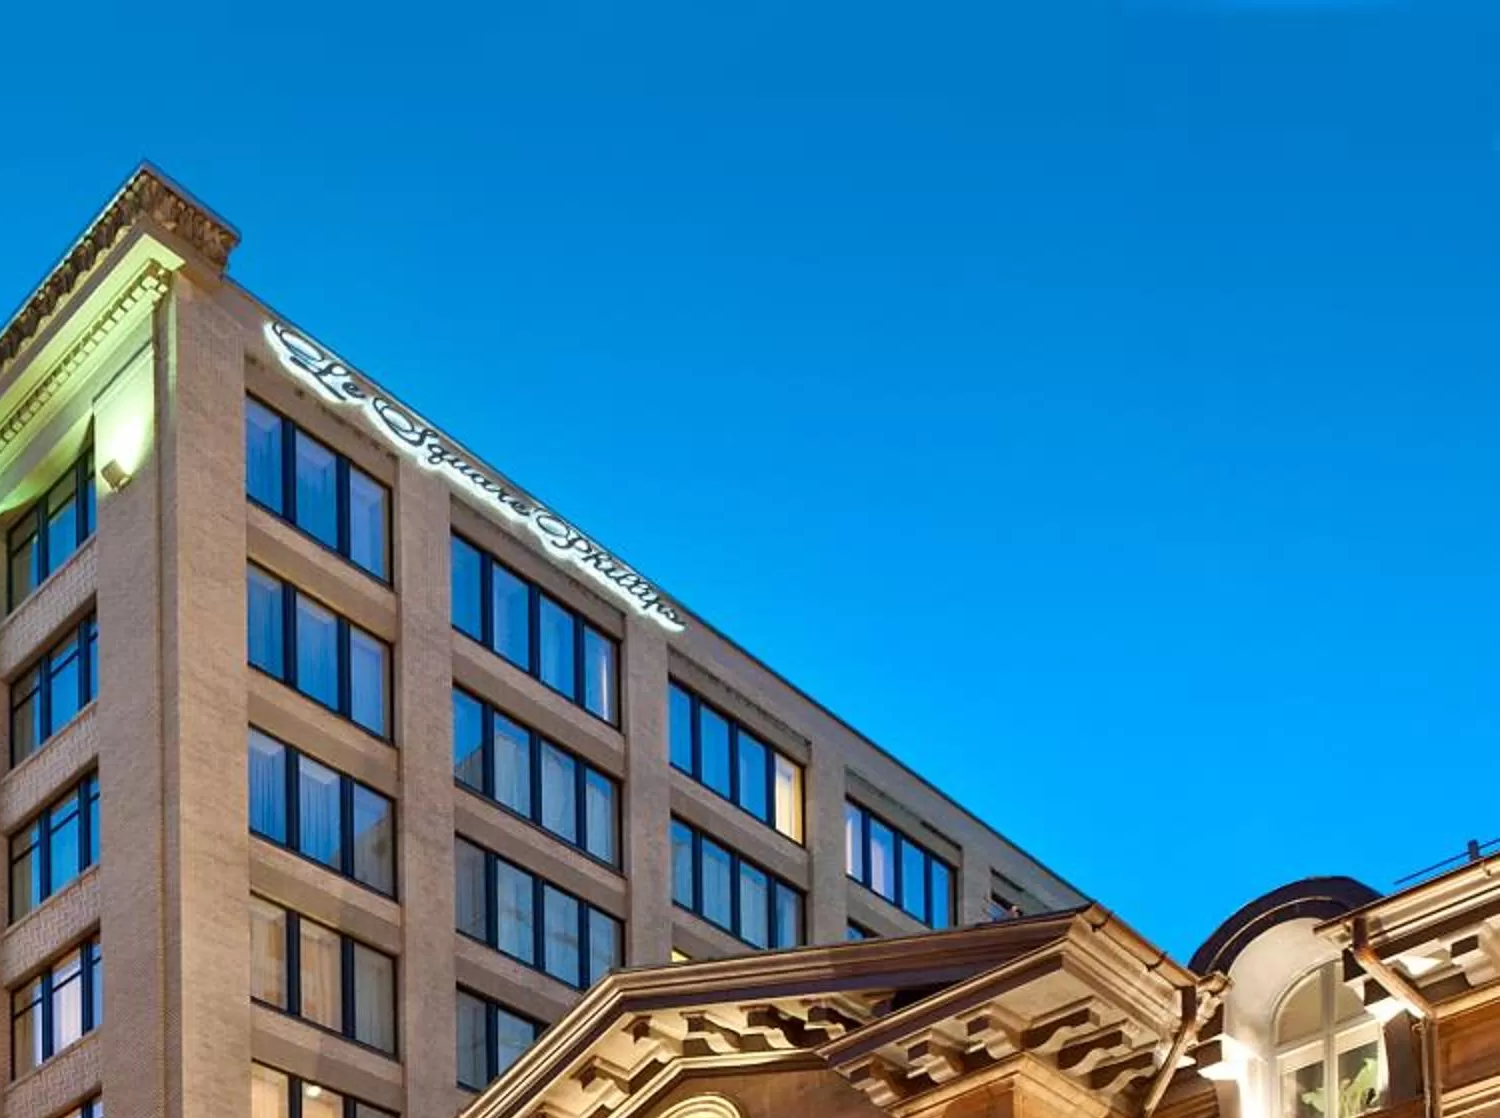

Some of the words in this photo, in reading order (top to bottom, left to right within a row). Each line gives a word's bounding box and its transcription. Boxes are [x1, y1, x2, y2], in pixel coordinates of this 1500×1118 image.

[271, 319, 367, 402] Le
[372, 397, 531, 516] Square
[533, 506, 685, 626] Phillips
